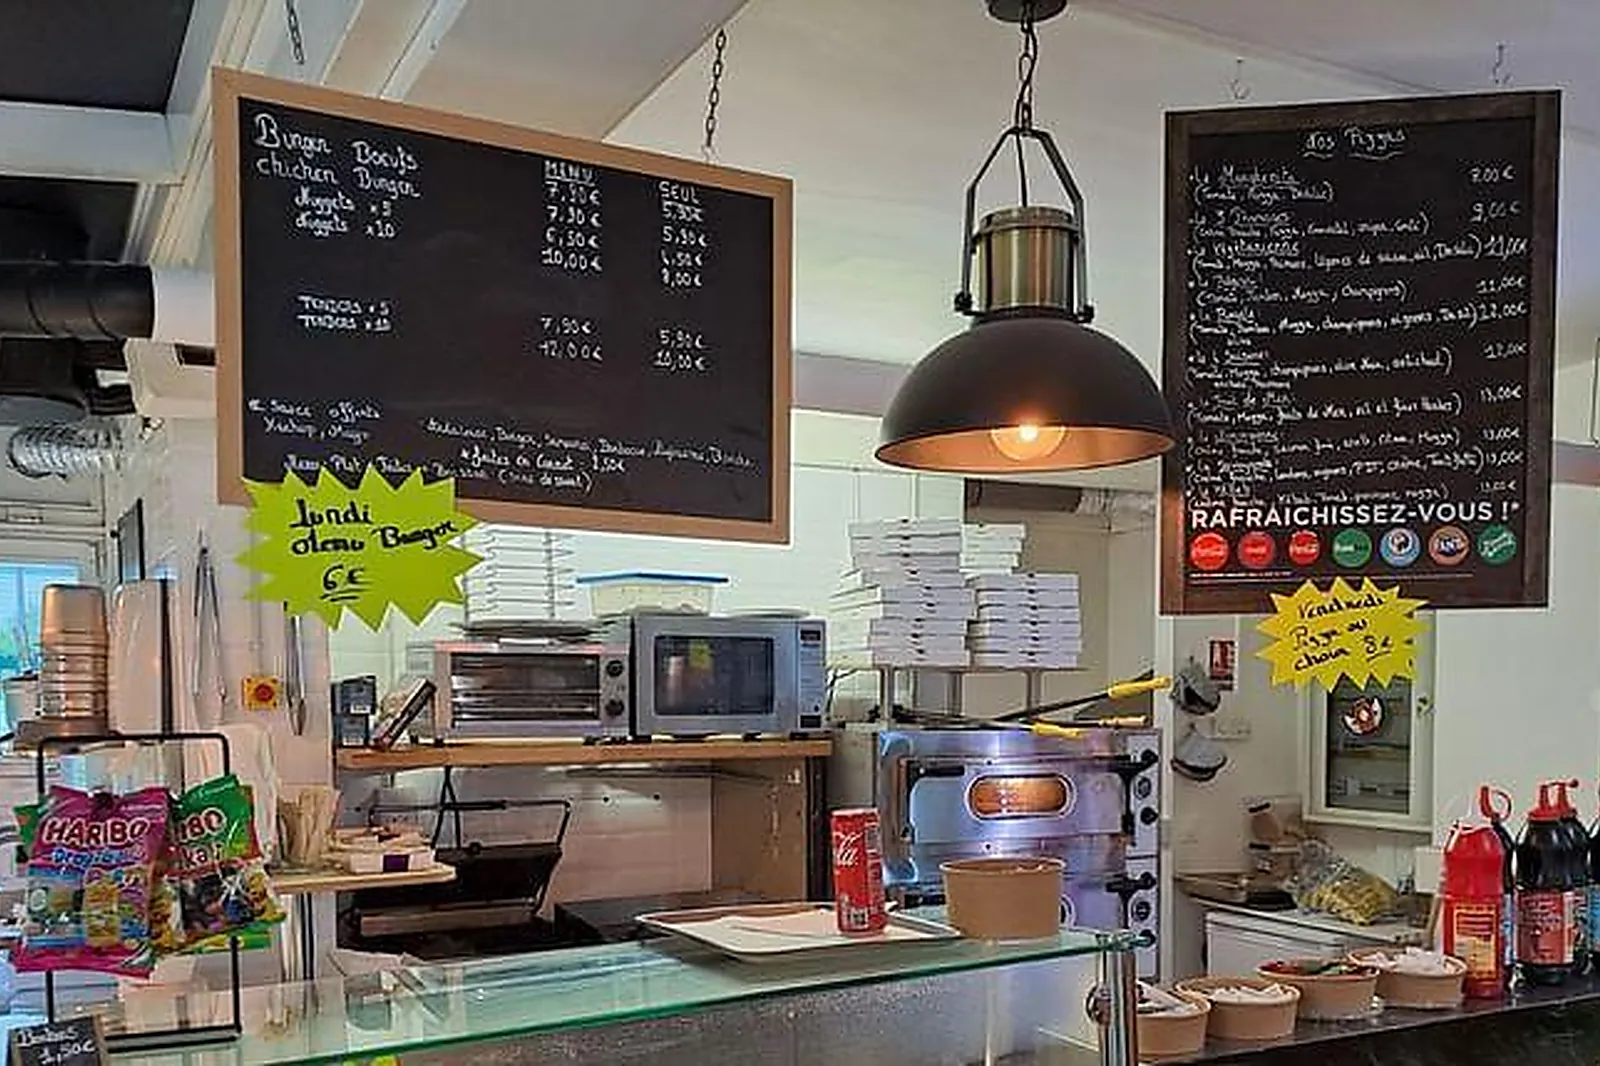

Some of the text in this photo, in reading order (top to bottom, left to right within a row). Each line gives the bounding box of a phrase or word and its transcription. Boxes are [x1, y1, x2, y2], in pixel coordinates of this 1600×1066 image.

[659, 180, 701, 205] SEUL
[1192, 501, 1493, 529] RAFRAICHISSEZ-VOUS
[42, 816, 150, 848] HARIBO
